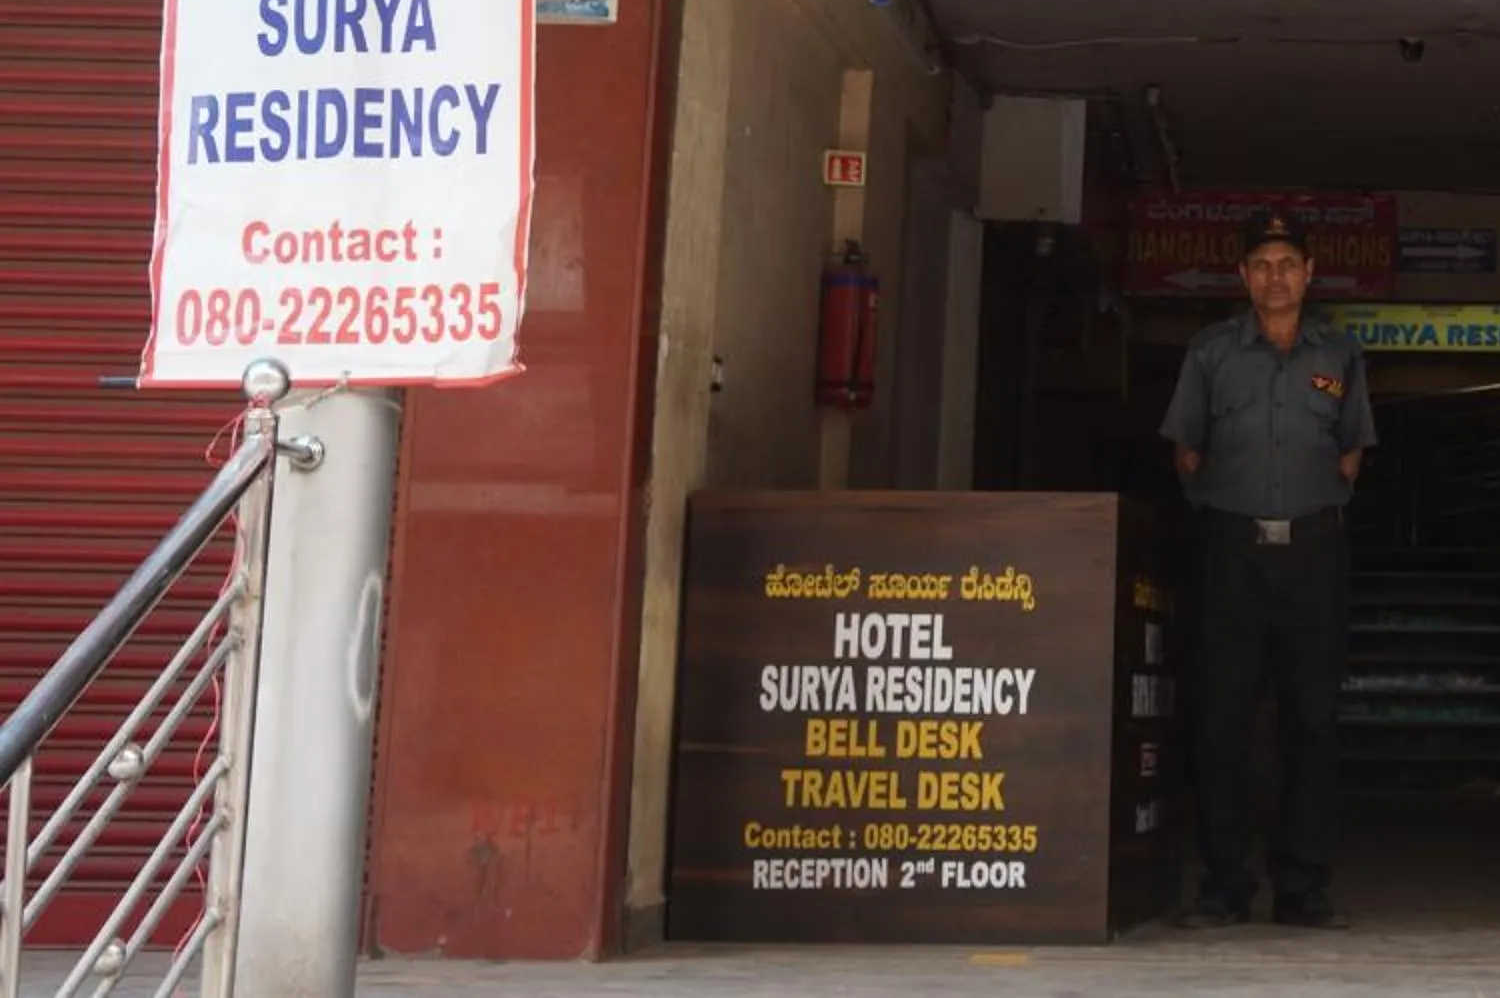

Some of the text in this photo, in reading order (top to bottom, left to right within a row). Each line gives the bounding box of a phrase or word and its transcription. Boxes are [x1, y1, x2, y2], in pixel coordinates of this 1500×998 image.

[187, 83, 501, 165] RESIDENCY
[176, 282, 502, 346] 080-22265335
[834, 612, 953, 659] HOTEL
[760, 665, 1036, 715] SURYA RESIDENCY
[806, 718, 984, 760] BELL DESK
[781, 769, 1005, 811] TRAVEL DESK
[864, 823, 1038, 852] 080-22265335
[753, 857, 1026, 890] RECEPTION 2nd FLOOR
